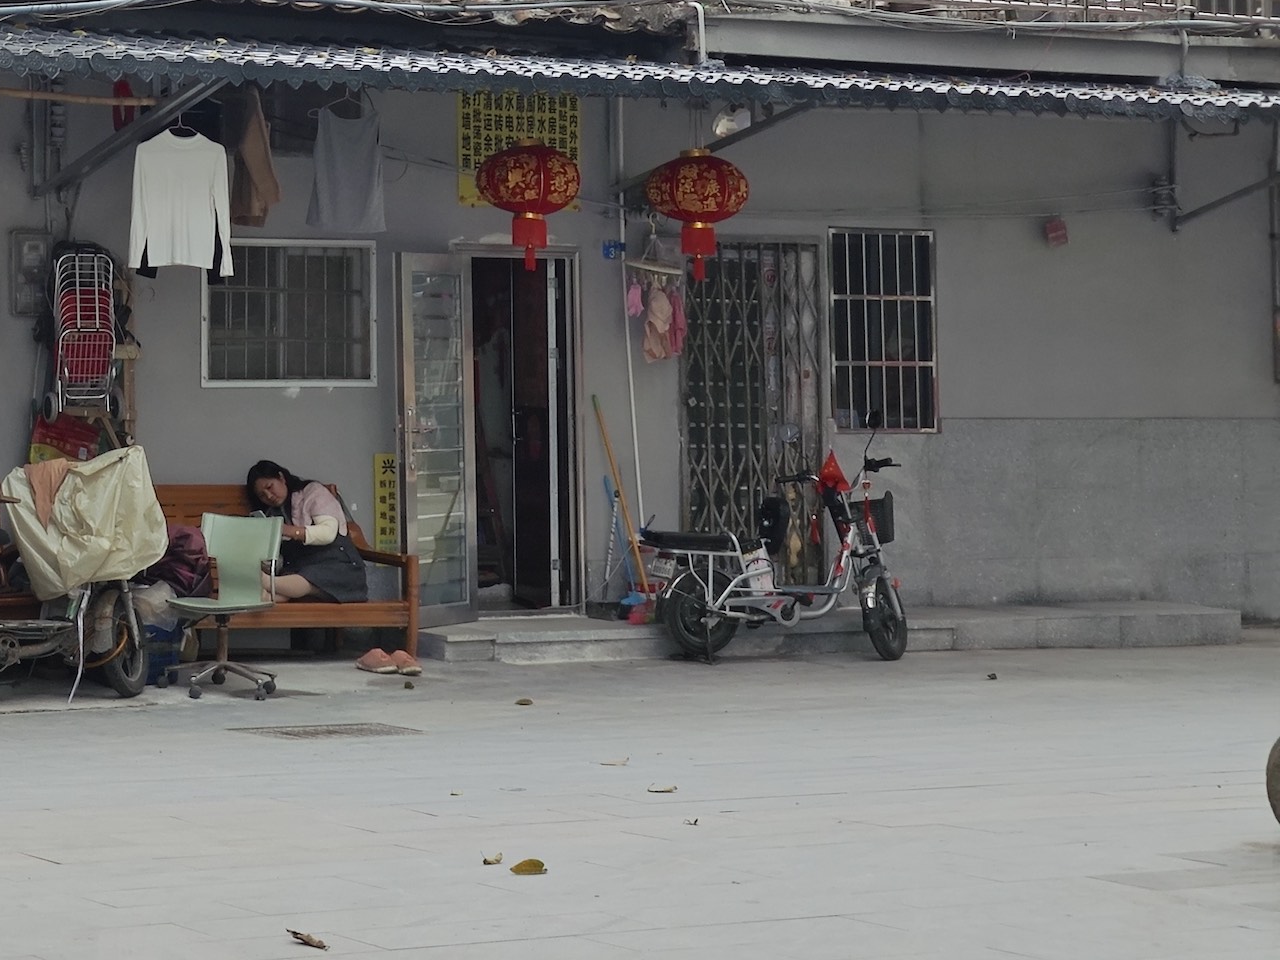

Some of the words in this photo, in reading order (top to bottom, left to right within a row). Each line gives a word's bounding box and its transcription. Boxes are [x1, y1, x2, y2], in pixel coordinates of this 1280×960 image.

[483, 92, 493, 159] 清运余
[537, 95, 546, 144] 防水
[558, 96, 568, 154] 铺贴地面
[382, 459, 396, 474] 兴
